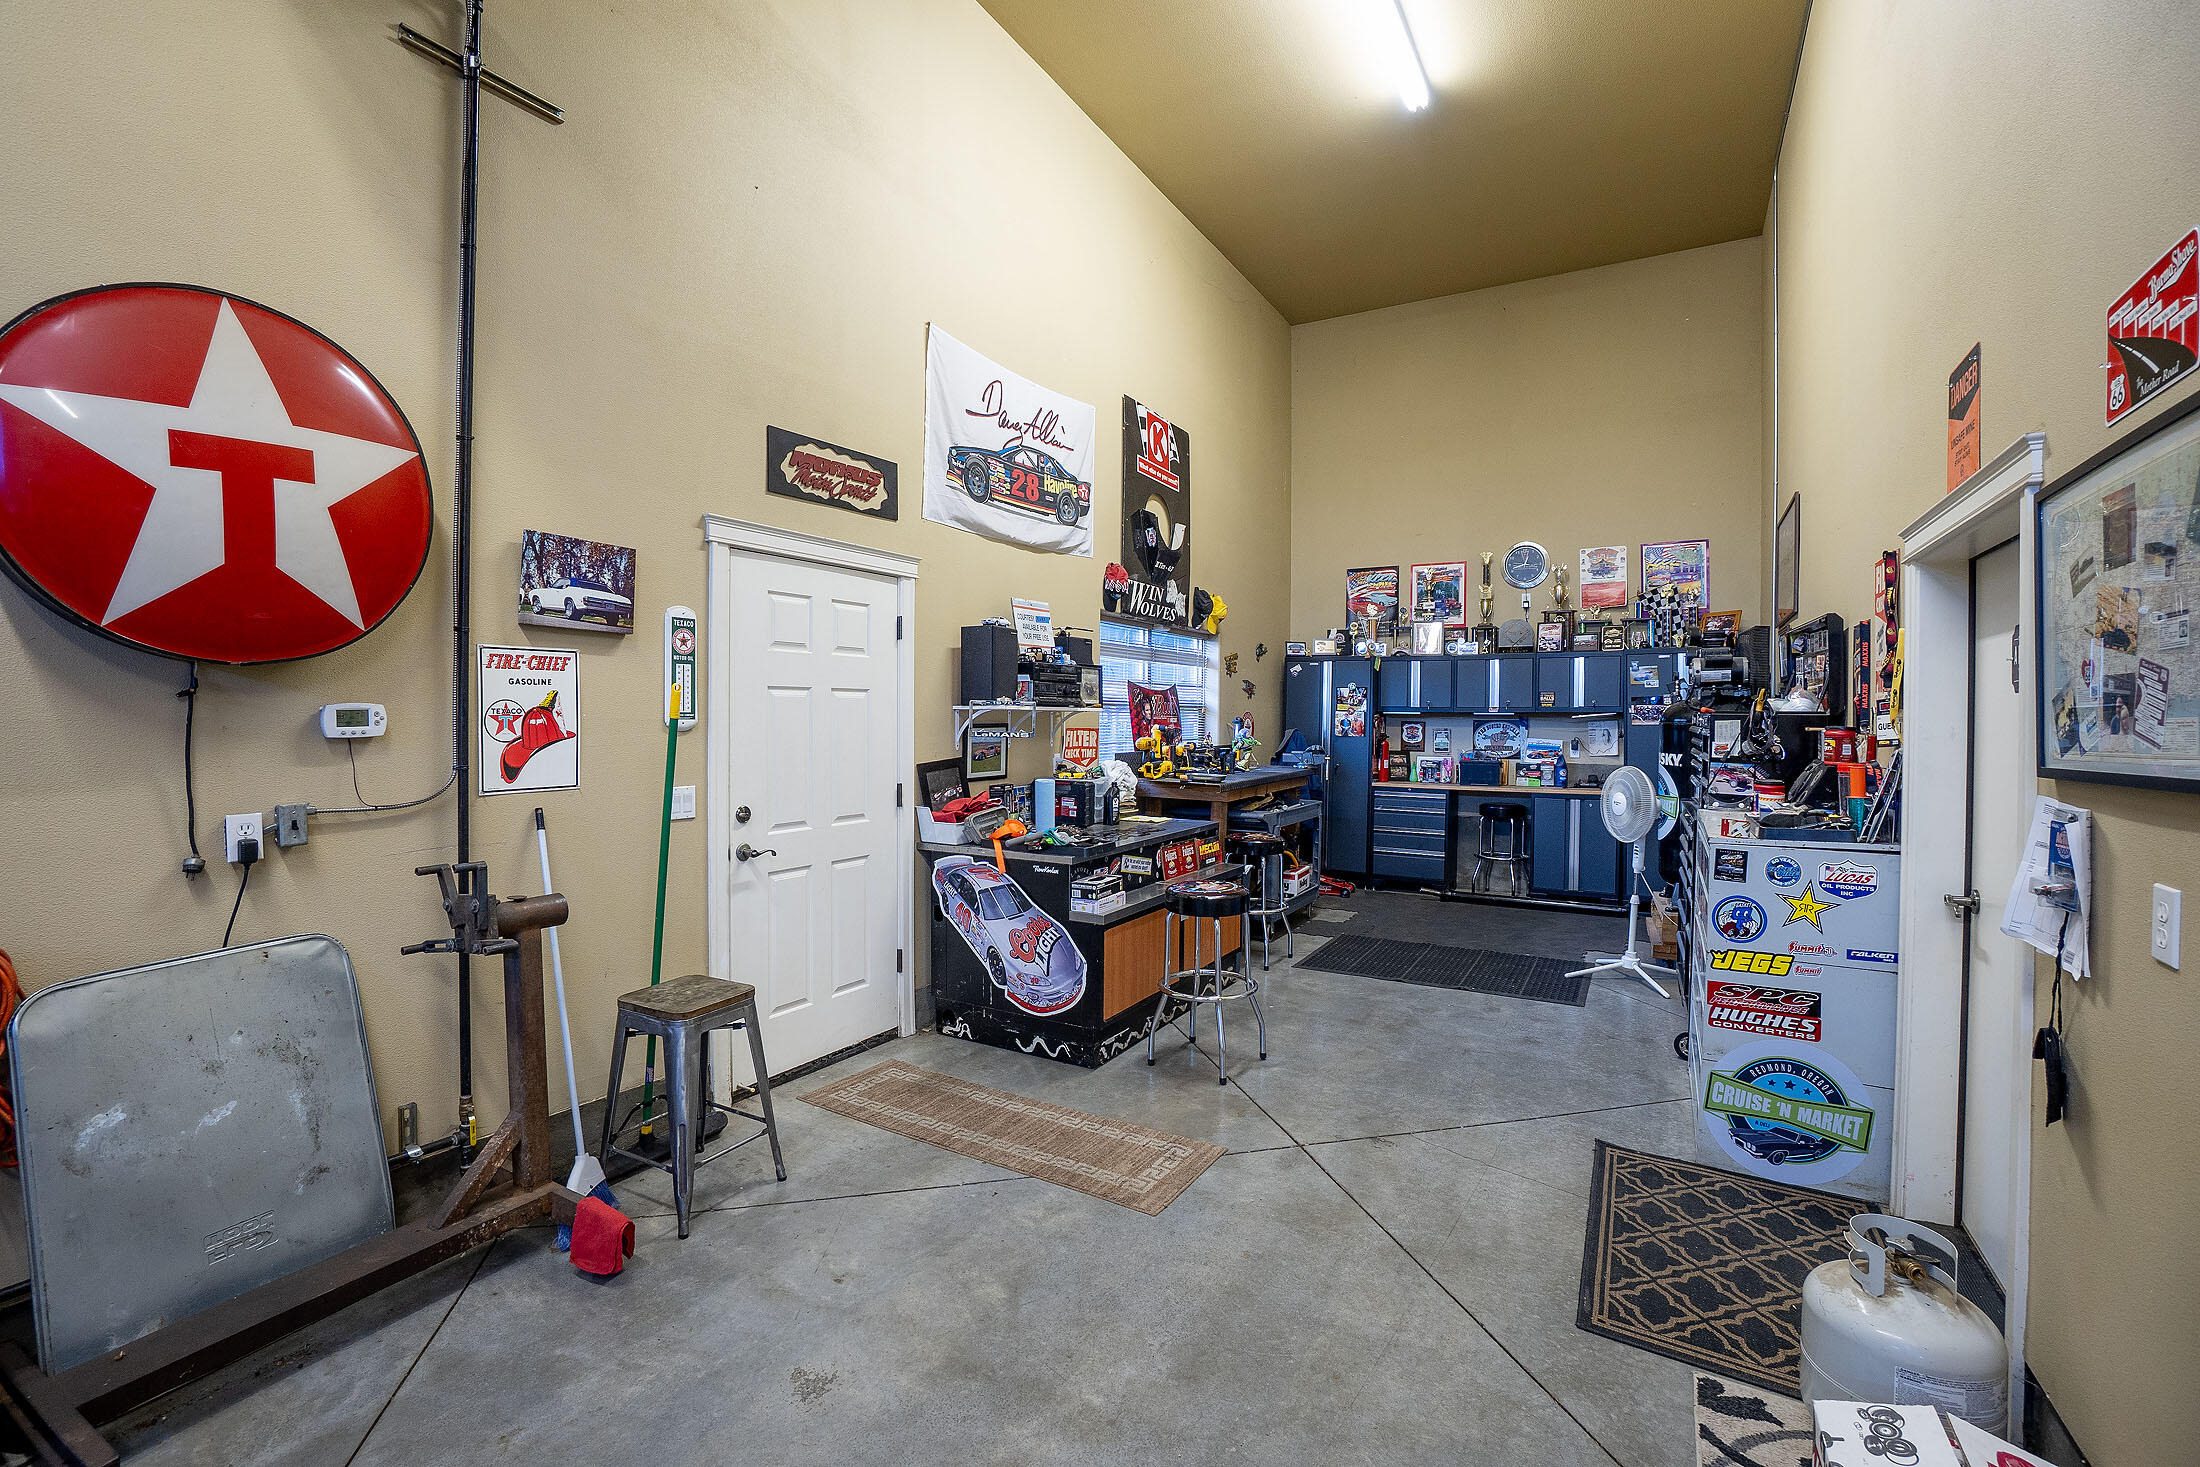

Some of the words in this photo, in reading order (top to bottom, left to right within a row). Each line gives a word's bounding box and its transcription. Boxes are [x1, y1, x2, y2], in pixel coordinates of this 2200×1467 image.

[2148, 239, 2198, 304] Burma-Shave
[1950, 362, 1978, 410] DANGER
[2140, 374, 2161, 397] Mother
[2162, 360, 2180, 384] Road
[2111, 388, 2124, 408] 66
[1011, 468, 1040, 502] 28
[1044, 473, 1078, 498] Havoline
[673, 618, 695, 629] TEXACO
[486, 653, 572, 672] FIRE-CHIEF
[1861, 641, 1869, 668] MAXXIS
[508, 678, 552, 686] GASOLINE
[1861, 683, 1869, 709] MAXXIS
[491, 707, 523, 716] TEXACO
[974, 730, 1030, 738] LeMANS
[1065, 729, 1098, 748] FILTER
[1064, 747, 1081, 759] CHECK
[1081, 748, 1097, 759] TIME
[1659, 752, 1683, 767] SKY.
[1825, 872, 1875, 884] LUCAS
[1835, 884, 1875, 892] PRODUCTS
[954, 901, 972, 933] 40
[1008, 915, 1054, 963] Coors
[1034, 926, 1063, 977] LIGHT
[1714, 951, 1793, 976] JEGS
[1850, 950, 1895, 960] FALKEN
[1713, 984, 1820, 1007] SPC
[1711, 1007, 1819, 1032] HUGHES
[1712, 1020, 1817, 1040] CONVERTERS
[1749, 1063, 1797, 1078] REDMOND,
[1801, 1068, 1834, 1096] OREGON
[1712, 1081, 1771, 1113] CRUISE
[1797, 1105, 1863, 1141] MARKET
